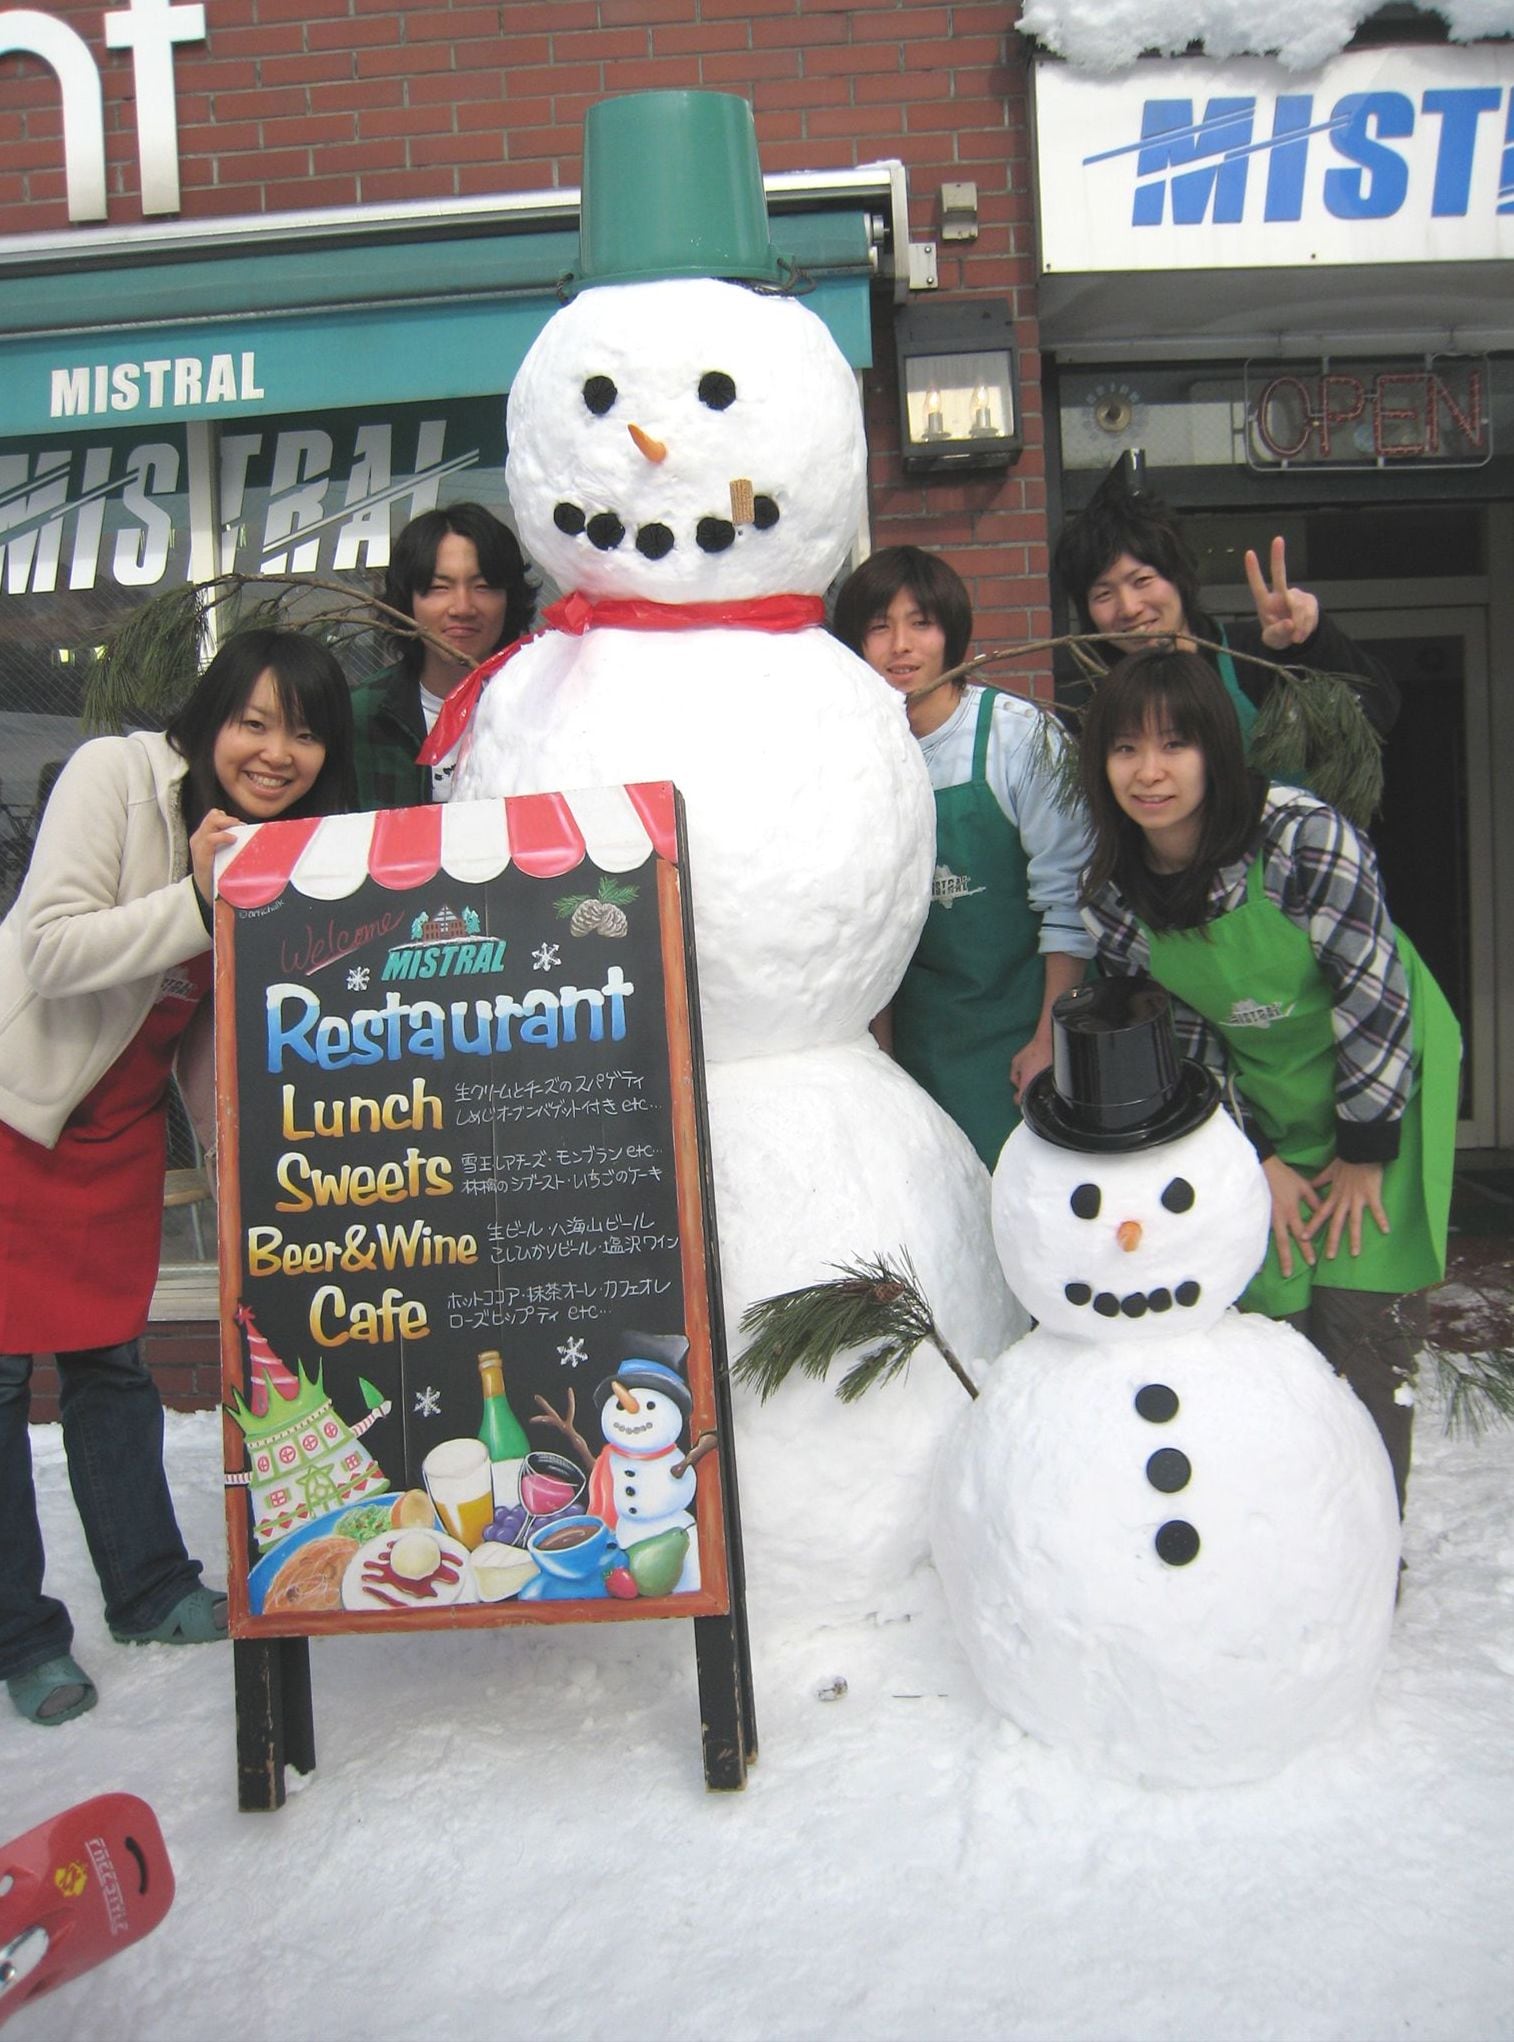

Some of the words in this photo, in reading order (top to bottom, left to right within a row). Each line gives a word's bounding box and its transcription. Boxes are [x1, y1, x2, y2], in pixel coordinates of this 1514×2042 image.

[1132, 86, 1514, 227] MIST
[50, 351, 265, 418] MISTRAL
[1257, 369, 1486, 458] OPEN
[280, 910, 405, 974] Welcome
[381, 939, 507, 981] MISTRAL
[265, 965, 635, 1073] Restaurant
[282, 1077, 445, 1141] Lunch
[275, 1147, 454, 1212] Sweets
[248, 1219, 479, 1277] Beer&Wine
[309, 1285, 431, 1345] Cafe
